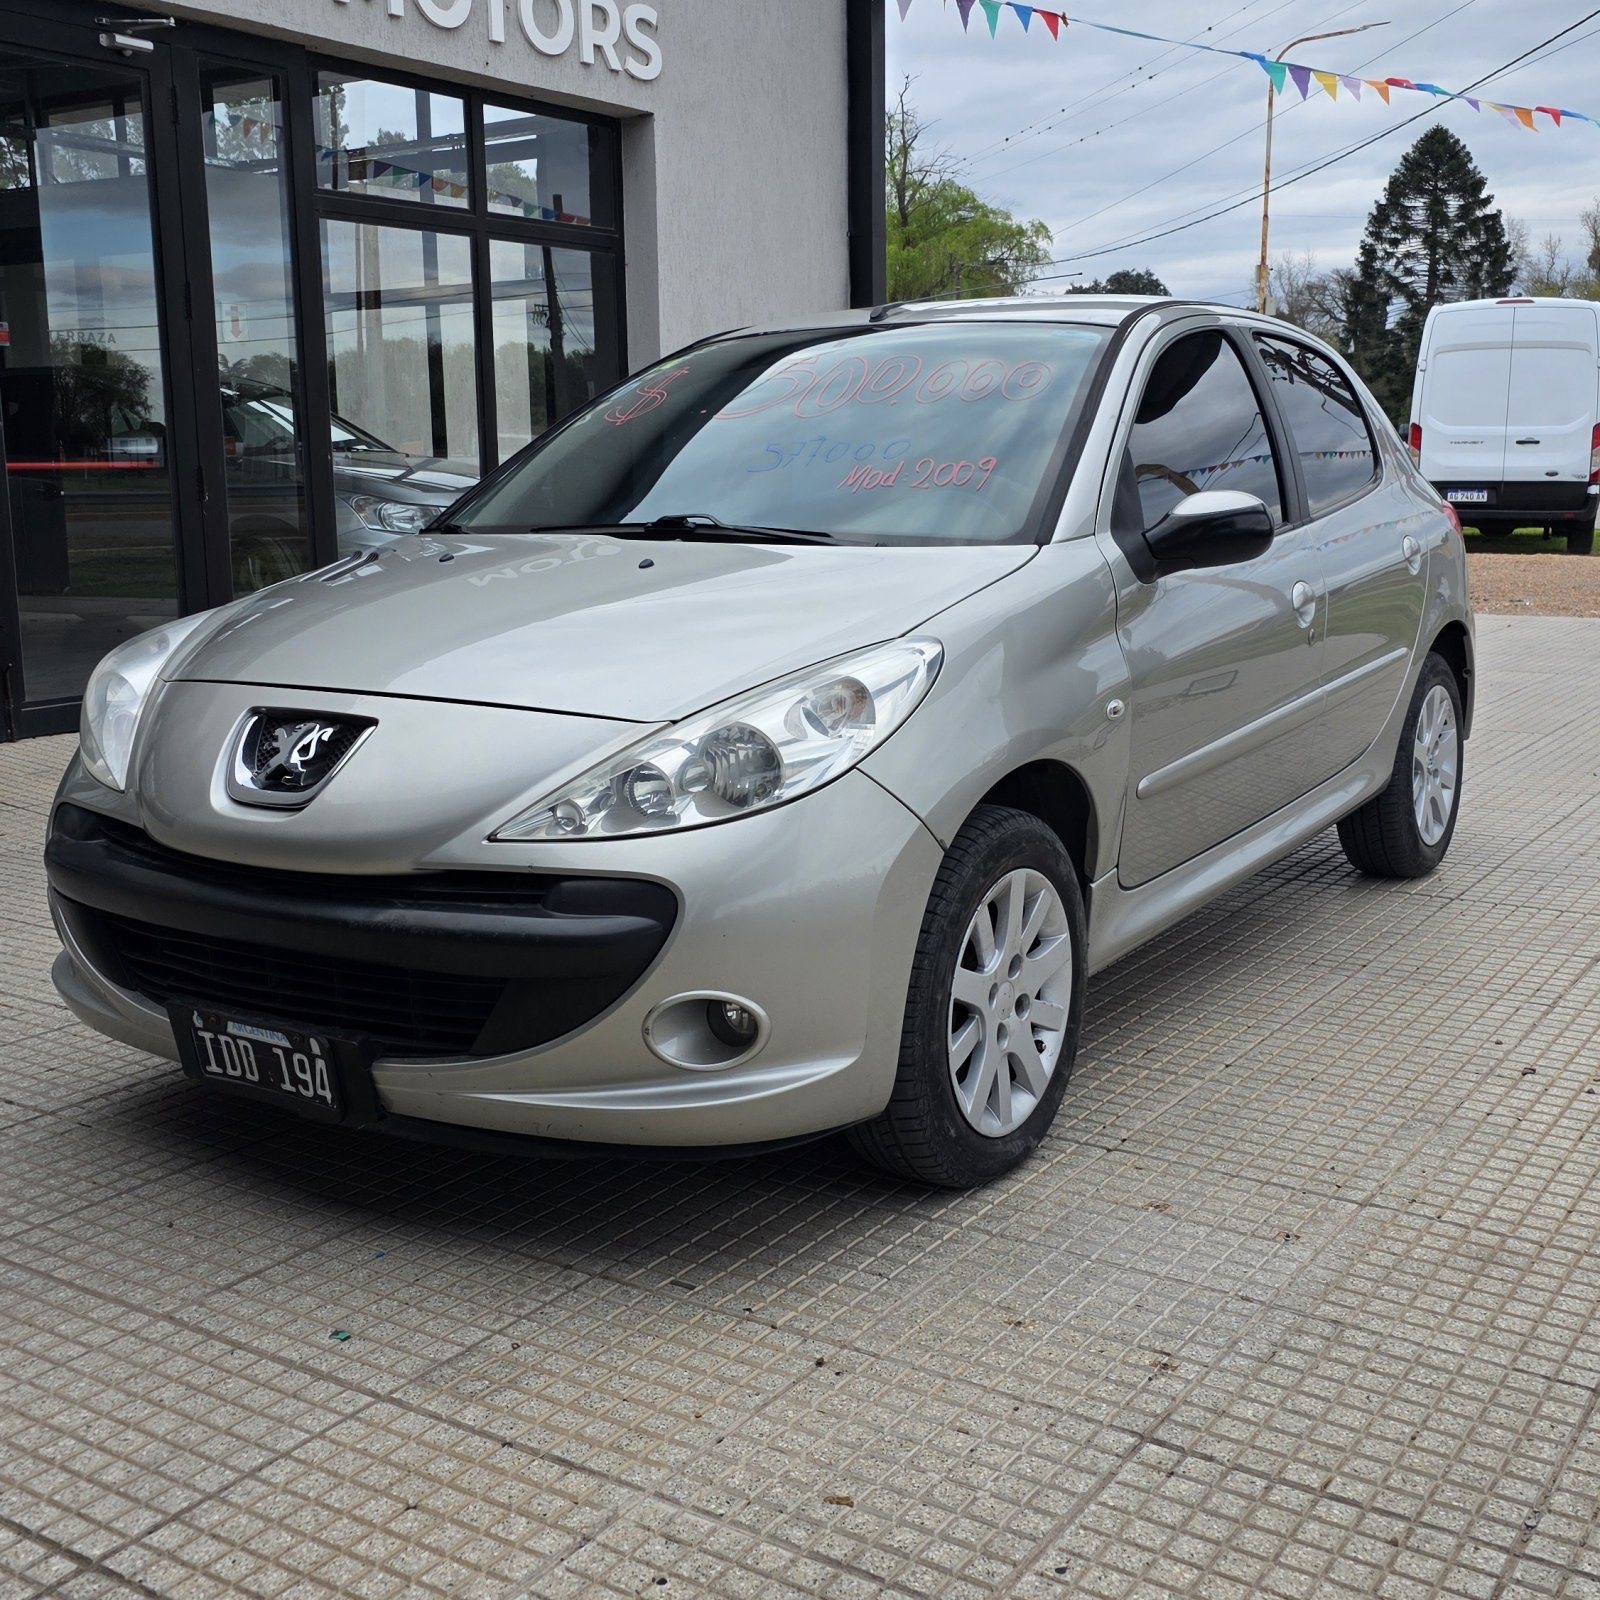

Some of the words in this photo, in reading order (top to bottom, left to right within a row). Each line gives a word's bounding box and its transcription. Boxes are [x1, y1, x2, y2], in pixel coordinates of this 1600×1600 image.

[334, 0, 662, 81] TORS
[910, 456, 997, 492] 2009
[272, 1047, 332, 1105] 194
